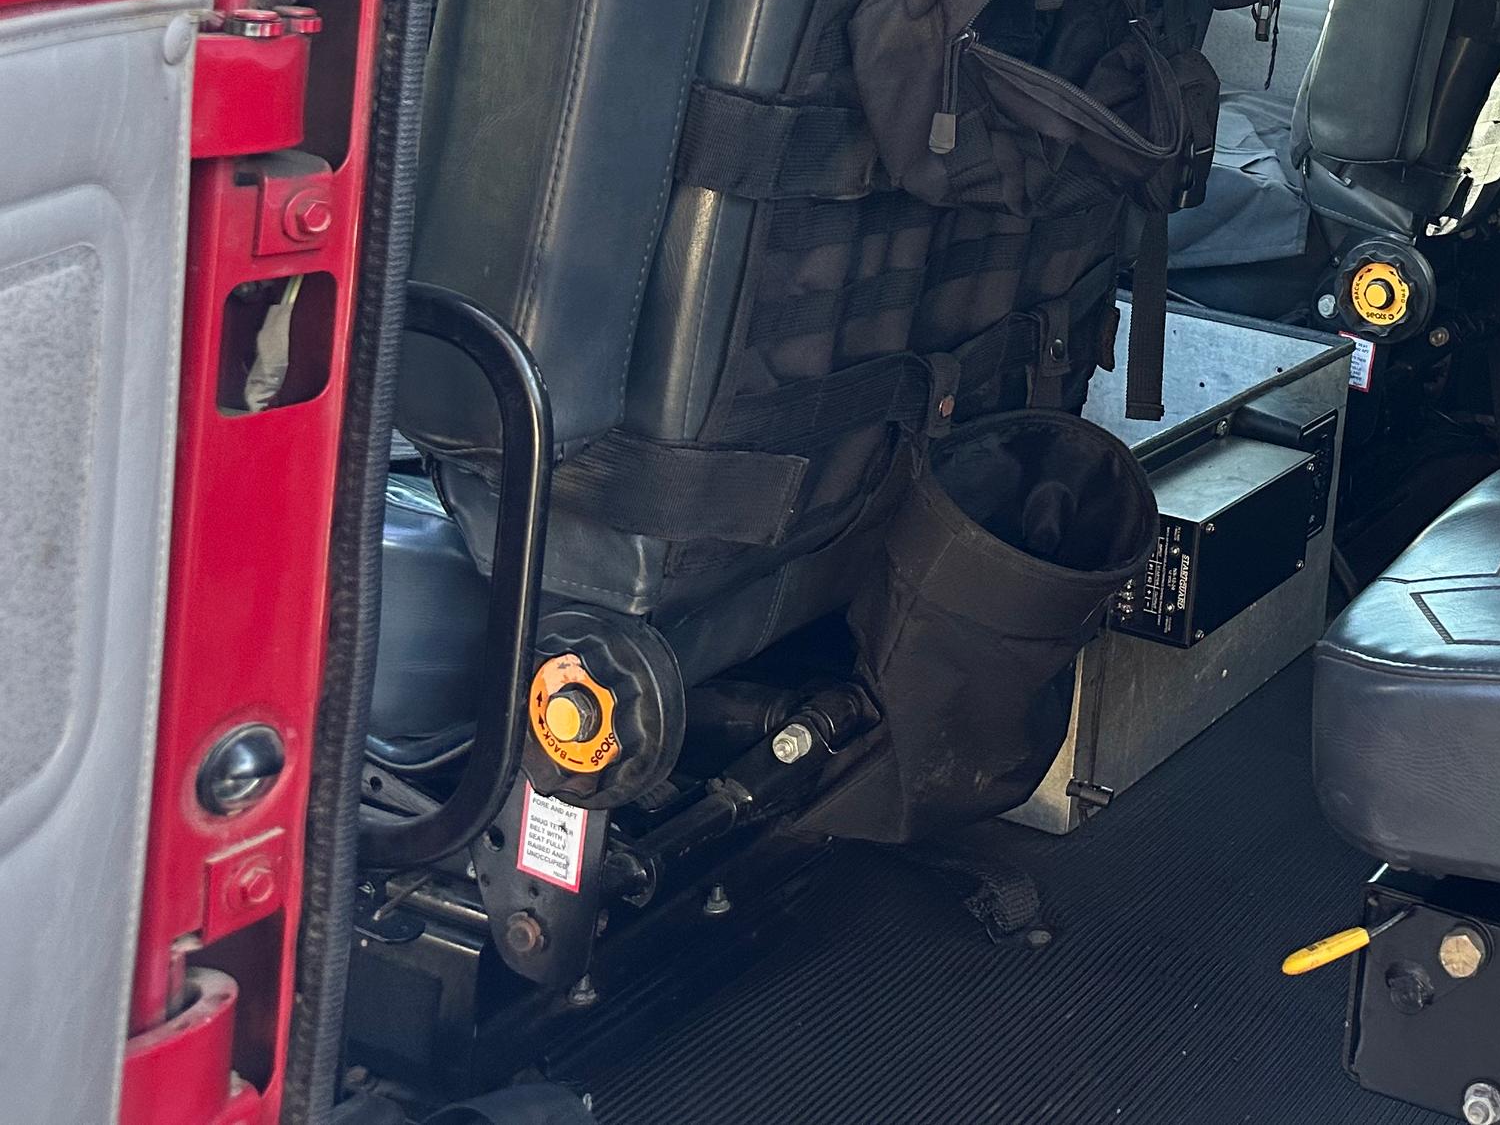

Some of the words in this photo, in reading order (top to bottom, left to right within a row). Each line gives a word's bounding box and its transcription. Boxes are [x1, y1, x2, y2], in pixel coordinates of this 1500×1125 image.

[1366, 311, 1387, 321] seats
[1176, 553, 1190, 611] STARTGUARD
[544, 731, 567, 760] BACK
[591, 732, 616, 766] seats
[533, 797, 549, 809] FORE
[550, 805, 564, 815] AND
[565, 810, 577, 820] AFT
[531, 815, 548, 826] SNUG
[528, 832, 544, 843] SEAT
[529, 823, 545, 834] BELT
[546, 830, 563, 841] WITH
[527, 840, 551, 854] RAISED
[526, 849, 569, 870] UNOCCUPIED
